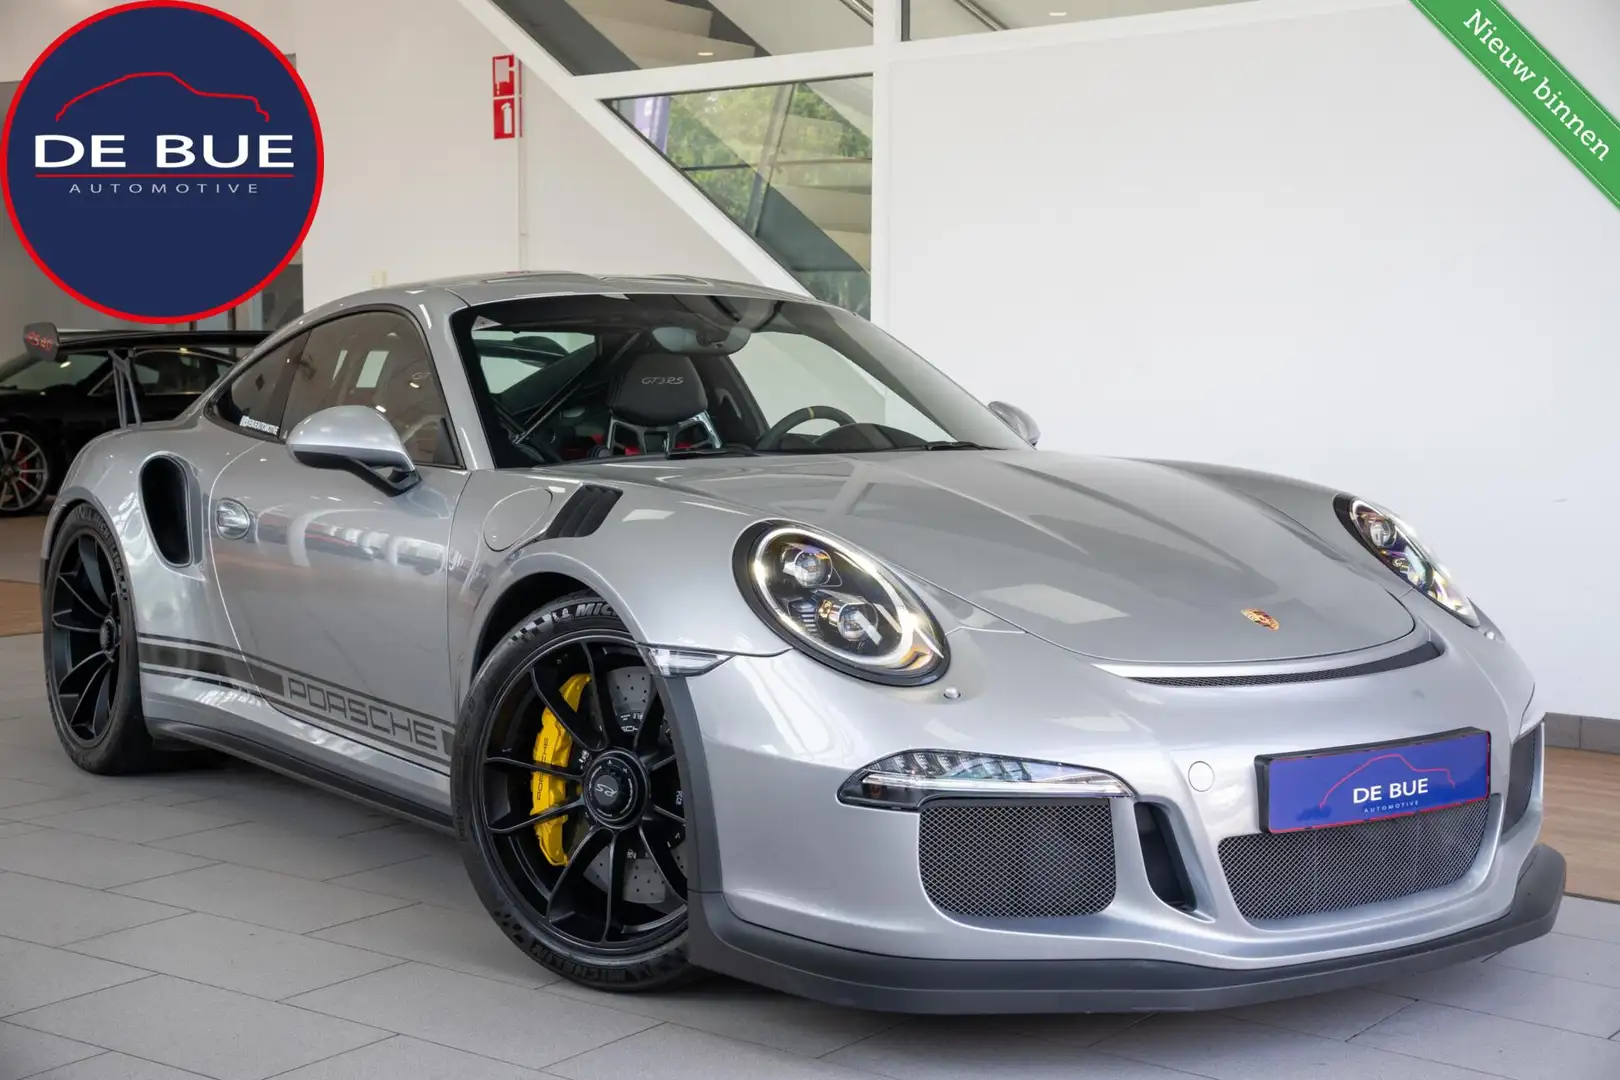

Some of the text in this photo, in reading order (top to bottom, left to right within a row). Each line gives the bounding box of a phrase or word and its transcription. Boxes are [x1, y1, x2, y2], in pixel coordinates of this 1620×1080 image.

[287, 677, 438, 751] PORSCHE
[1353, 777, 1429, 804] DE BUE
[1364, 800, 1419, 813] AUTOMOTIVE
